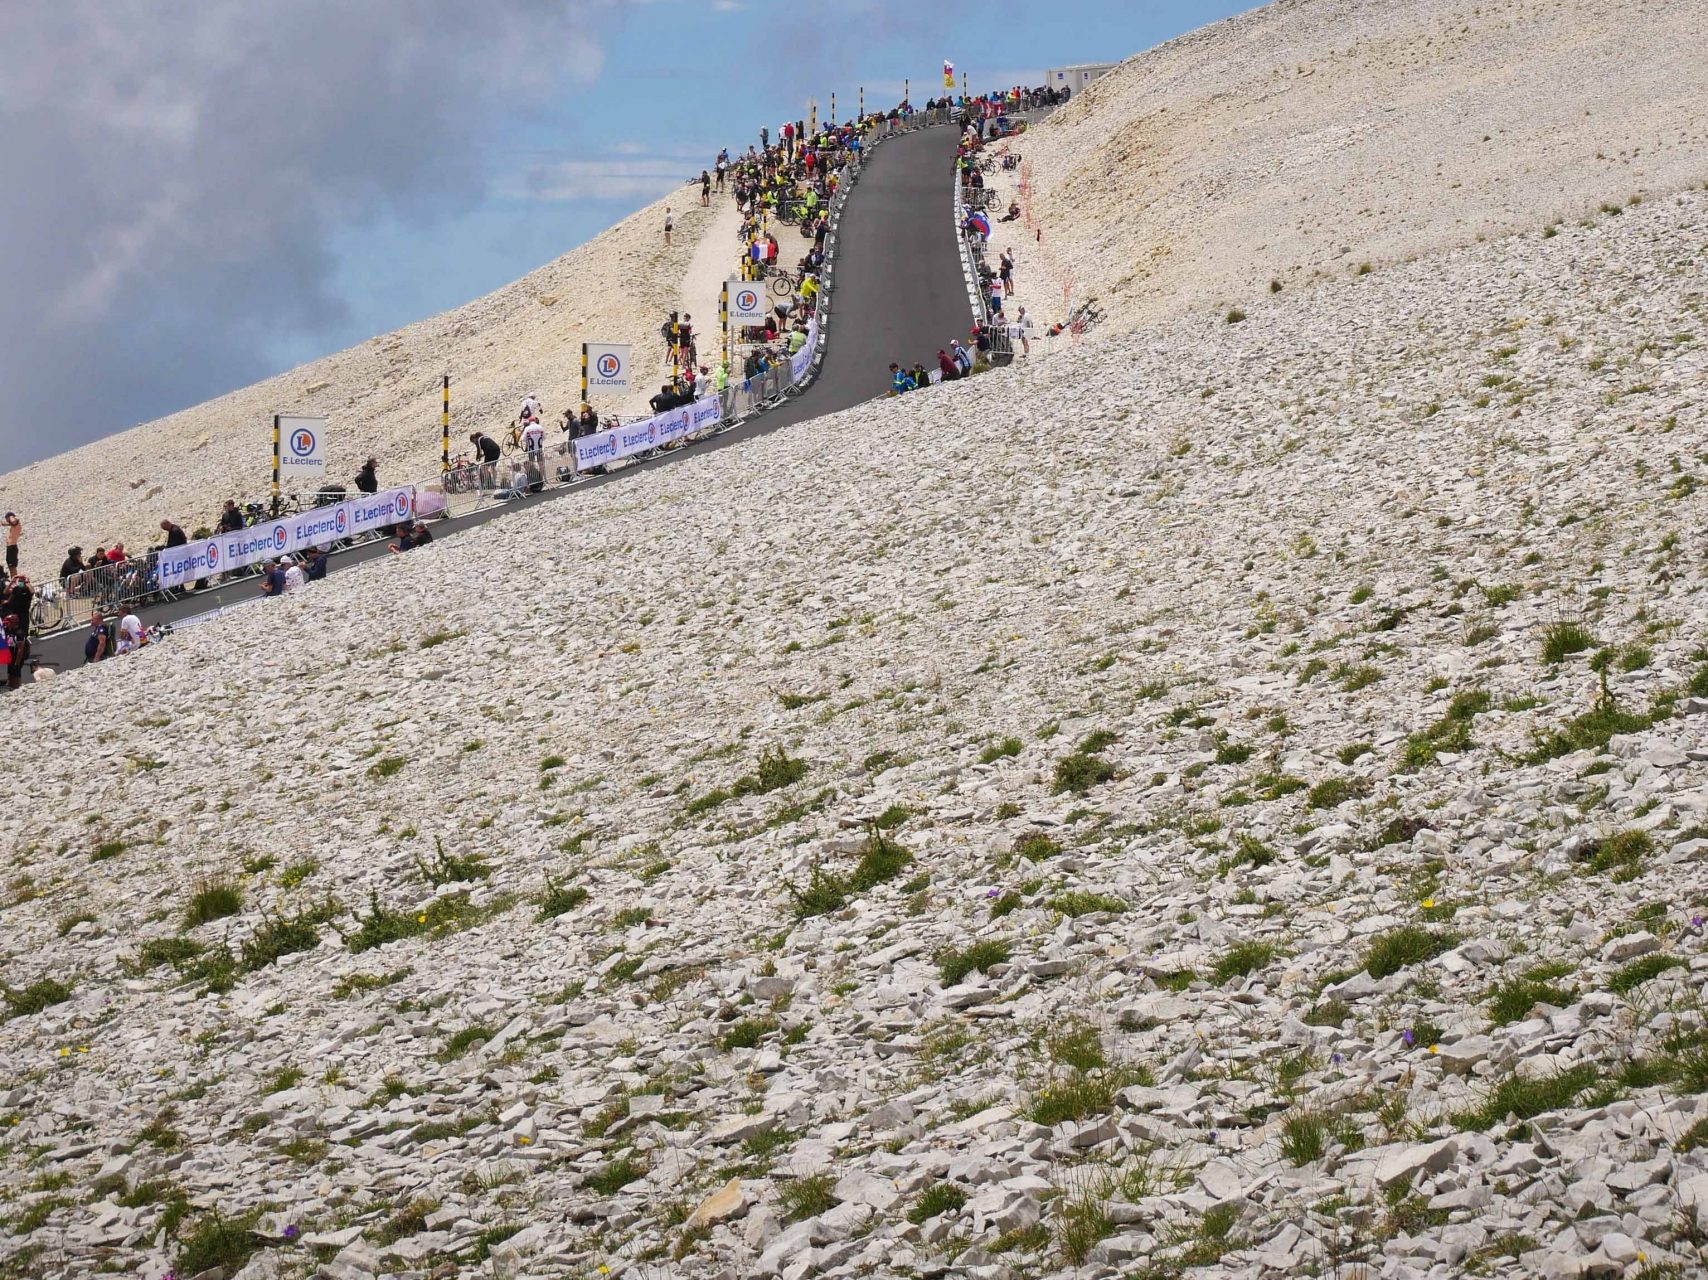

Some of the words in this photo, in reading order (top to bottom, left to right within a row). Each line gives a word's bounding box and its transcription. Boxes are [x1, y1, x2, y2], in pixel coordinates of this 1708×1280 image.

[623, 432, 647, 447] E.Leclerc
[283, 457, 323, 465] E.Leclerc
[580, 444, 610, 460] E.Leclerc
[355, 503, 394, 522] E.Leclerc
[297, 520, 335, 539] E.Leclerc
[229, 537, 272, 558] E.Leclerc
[162, 555, 206, 577] E.Leclerc
